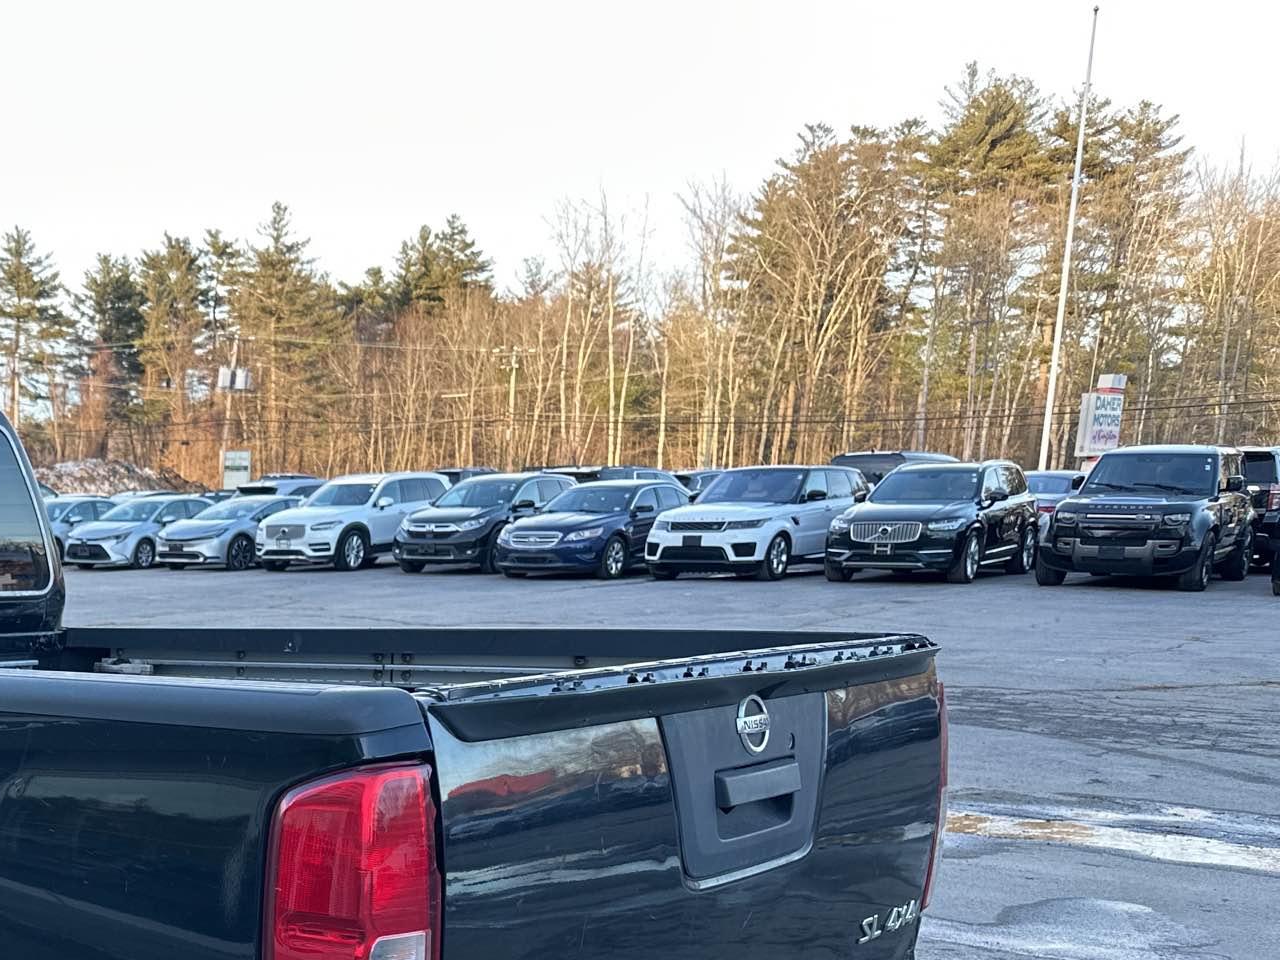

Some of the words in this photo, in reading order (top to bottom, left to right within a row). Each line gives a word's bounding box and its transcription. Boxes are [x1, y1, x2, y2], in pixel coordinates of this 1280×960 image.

[1094, 396, 1122, 411] DAHER
[1092, 414, 1120, 427] MOTORS
[858, 914, 882, 944] SL
